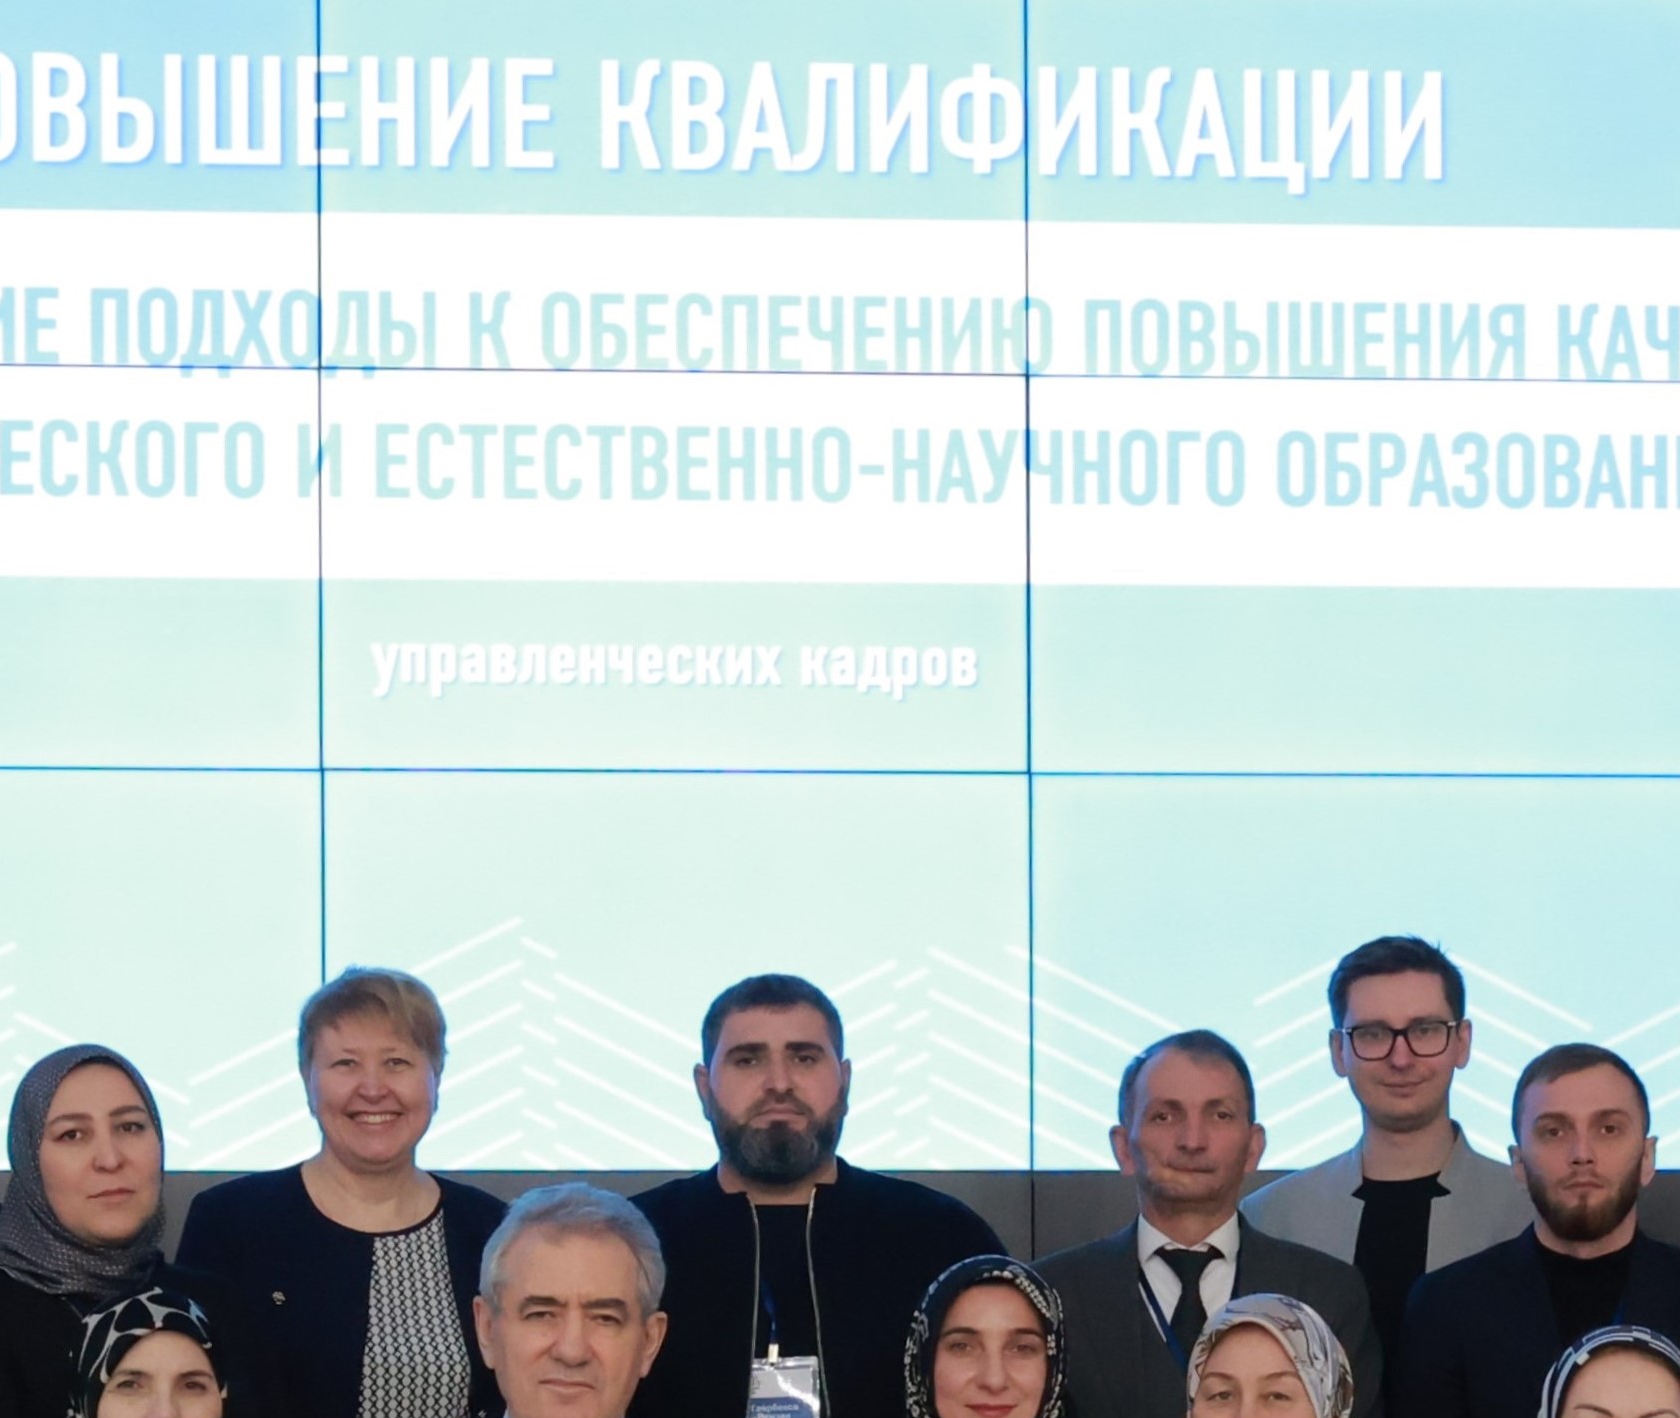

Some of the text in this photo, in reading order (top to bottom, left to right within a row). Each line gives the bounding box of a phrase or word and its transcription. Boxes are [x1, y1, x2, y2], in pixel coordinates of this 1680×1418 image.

[598, 56, 1449, 196] КВАЛИФИКАЦИИ
[88, 287, 439, 378] ПОДХОДЫ
[468, 291, 513, 370] К
[540, 292, 1054, 377] ОБЕСПЕЧЕНИЮ
[1082, 298, 1528, 382] ПОВЫШЕНИЯ
[296, 423, 345, 500] И
[374, 422, 1247, 508] ЕСТЕСТВЕННО-НАУЧНОГО
[370, 641, 979, 701] управленческих кадров
